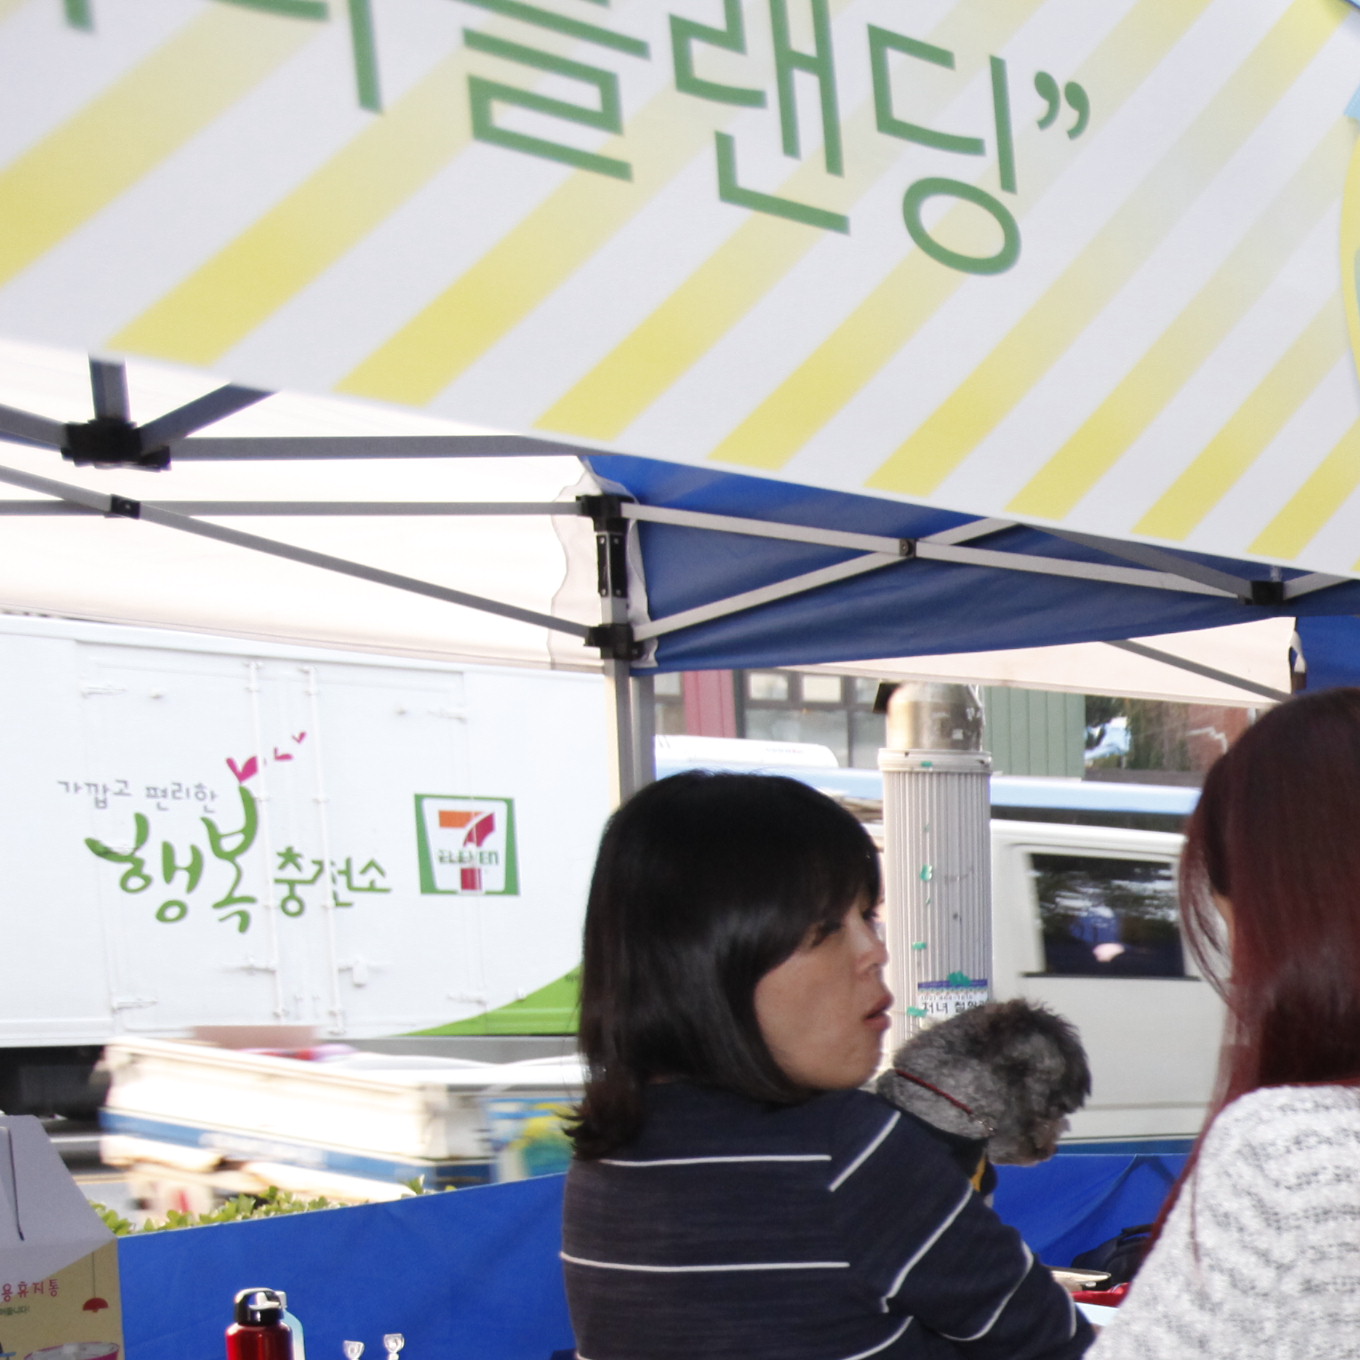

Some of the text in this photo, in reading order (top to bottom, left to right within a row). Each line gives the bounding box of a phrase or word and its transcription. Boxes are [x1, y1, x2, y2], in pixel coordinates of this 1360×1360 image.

[57, 779, 220, 814] 가깝고 편리한
[84, 785, 392, 934] 행복 충전소
